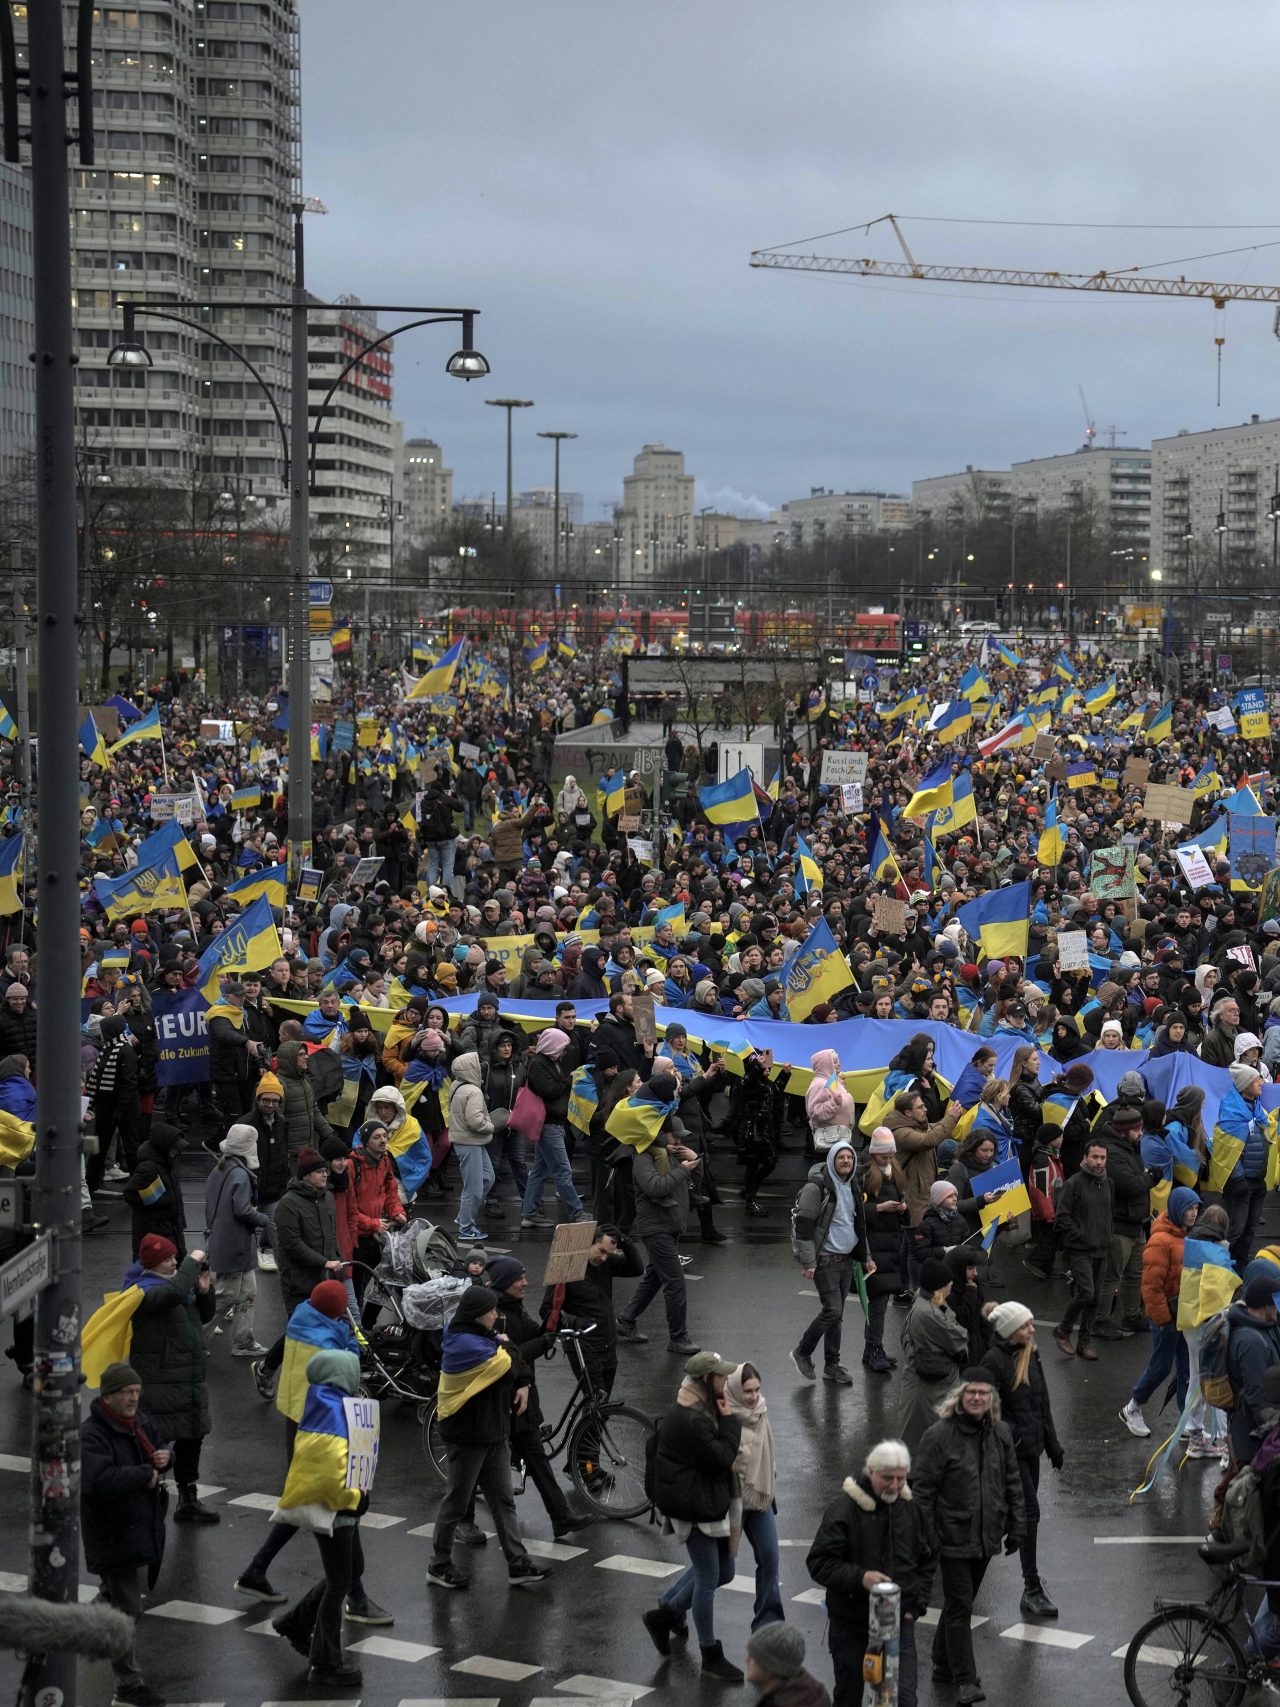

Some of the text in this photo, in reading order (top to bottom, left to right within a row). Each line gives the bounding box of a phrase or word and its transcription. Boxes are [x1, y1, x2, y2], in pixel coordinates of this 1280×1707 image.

[1244, 693, 1257, 702] WE
[1241, 700, 1264, 711] STAND
[827, 755, 864, 765] Russlands
[160, 1045, 210, 1060] die Zukunft
[354, 1402, 374, 1428] FULL
